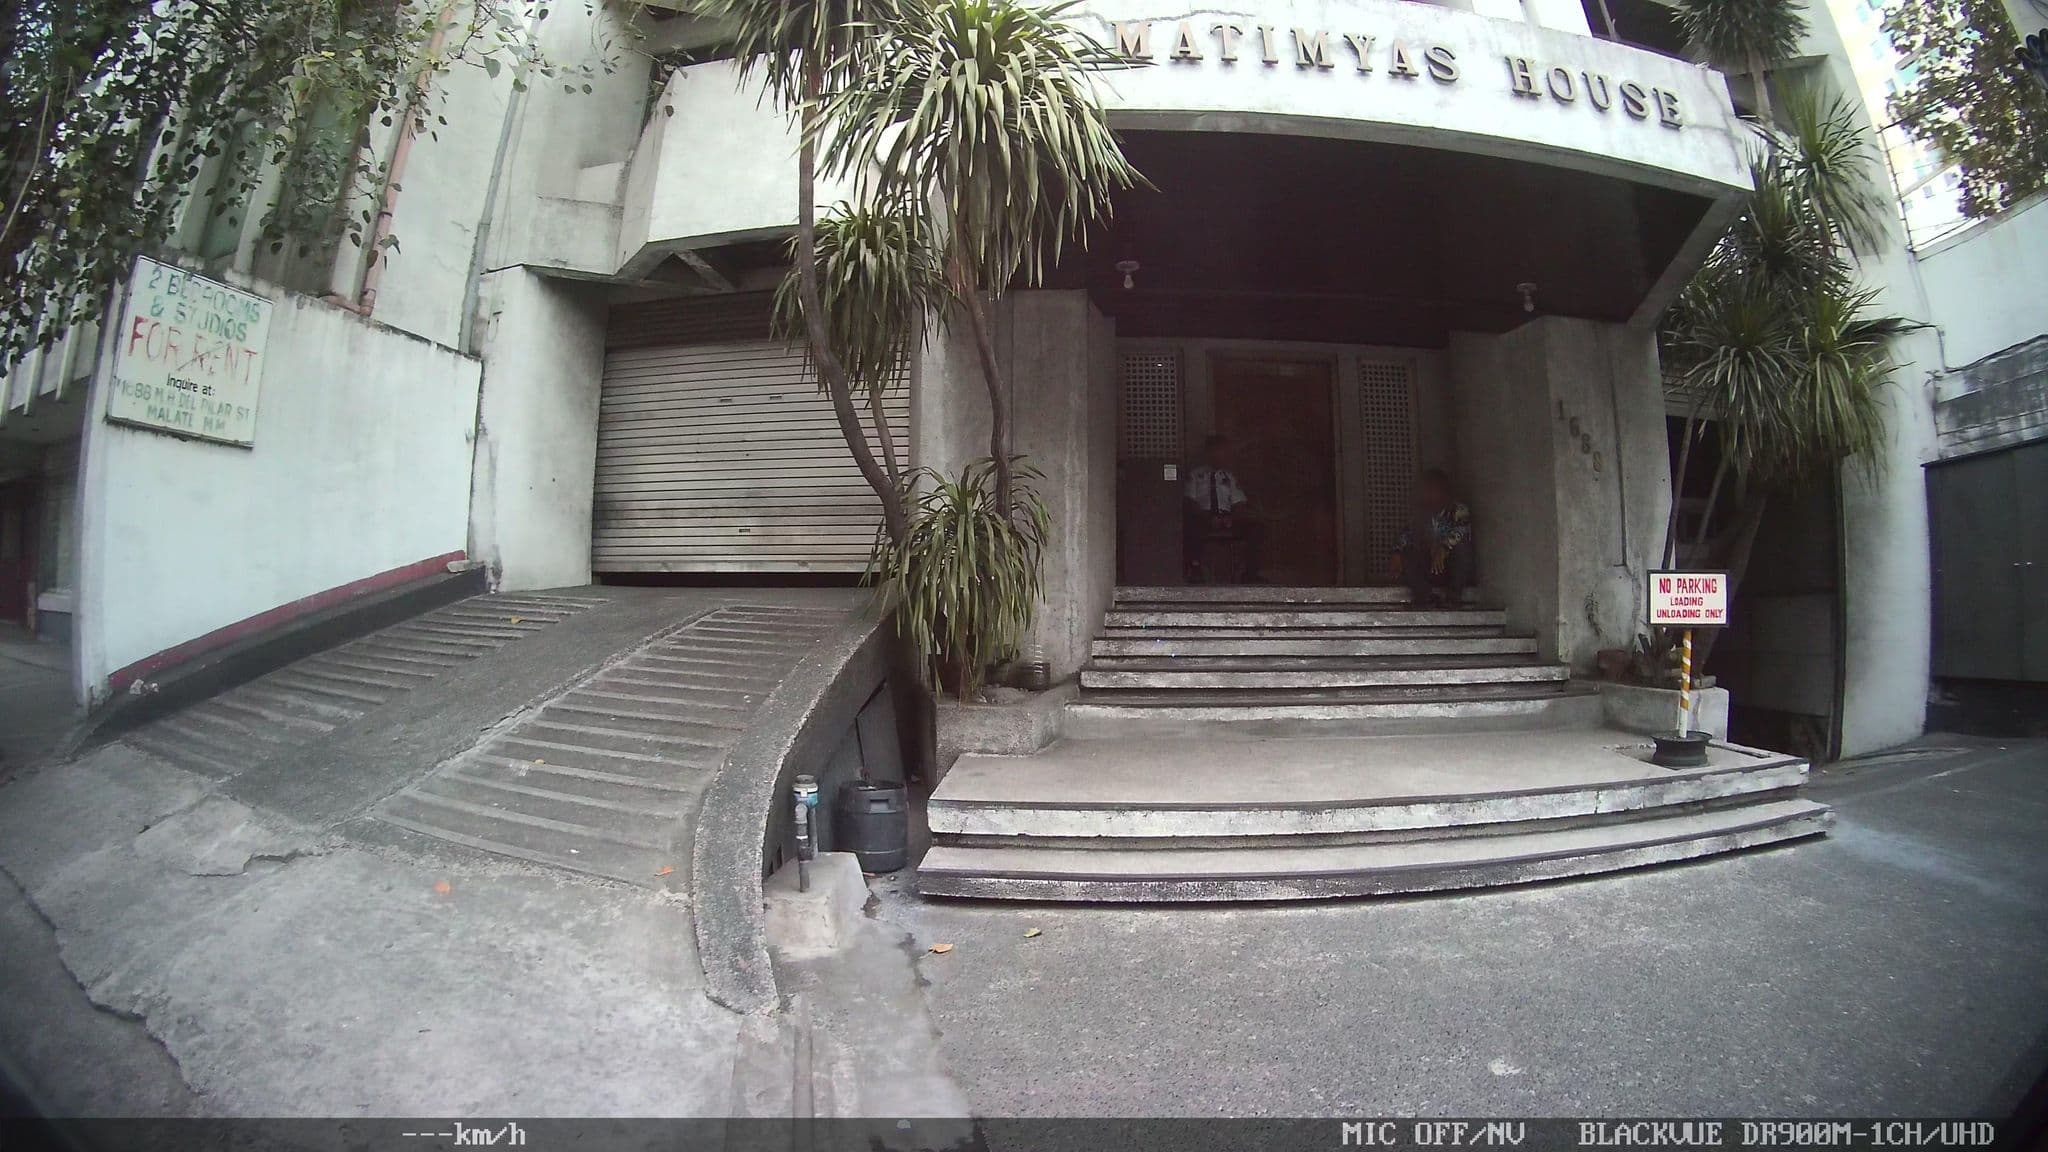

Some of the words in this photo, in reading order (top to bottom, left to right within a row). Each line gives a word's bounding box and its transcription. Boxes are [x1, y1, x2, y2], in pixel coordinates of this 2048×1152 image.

[1111, 21, 1460, 83] MATIMYAS
[1505, 54, 1684, 130] HOUSE
[148, 265, 162, 289] 2
[150, 295, 165, 317] &
[175, 302, 247, 342] STUDIOS
[128, 315, 180, 366] FOR
[166, 373, 198, 392] Inquire
[202, 384, 216, 397] at:
[1659, 578, 1672, 594] NO
[1677, 578, 1718, 594] PARKING
[1656, 609, 1701, 618] UNLOADING
[1705, 609, 1724, 618] ONLY
[1670, 597, 1704, 607] LOADING
